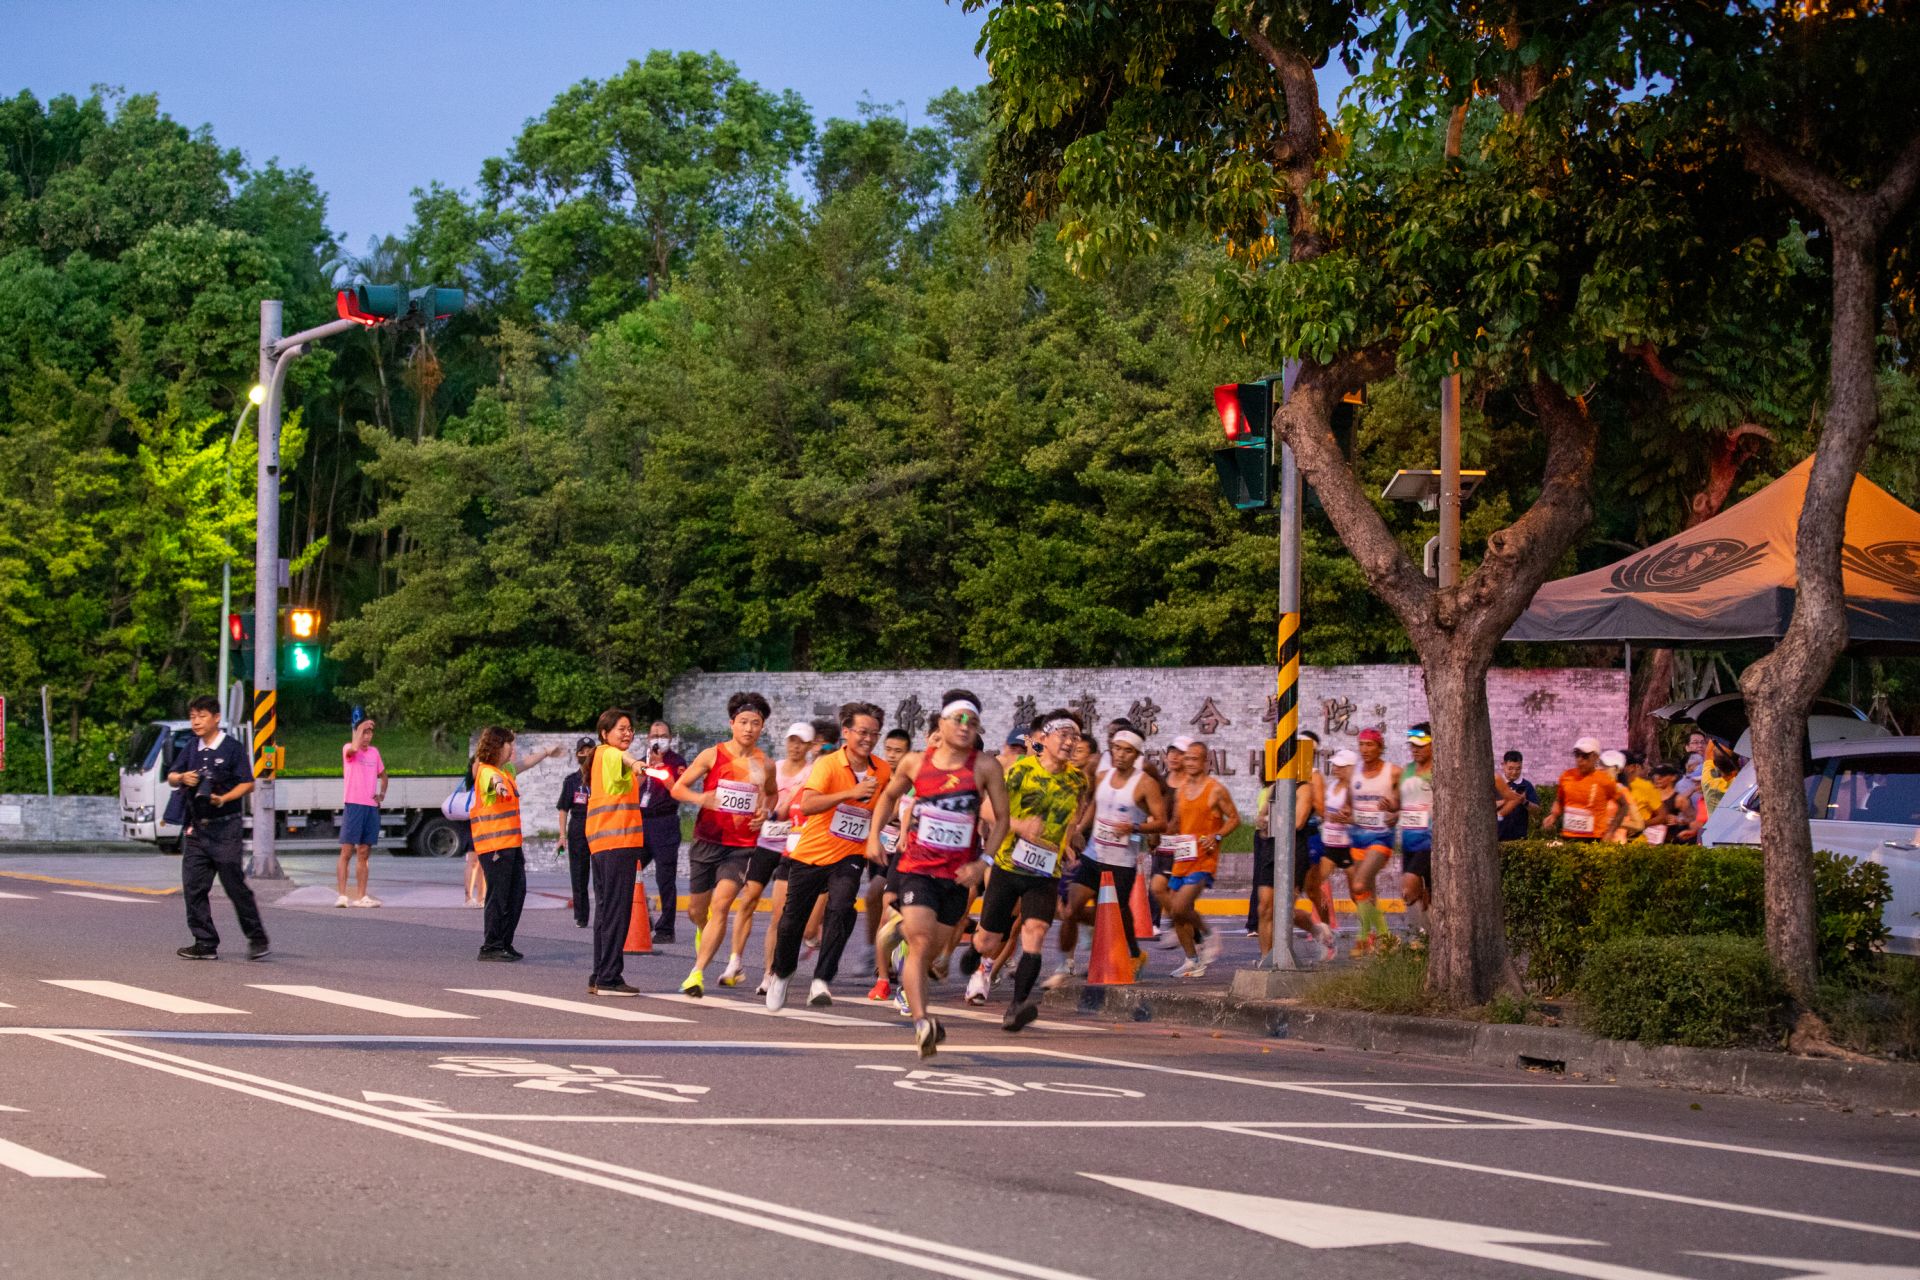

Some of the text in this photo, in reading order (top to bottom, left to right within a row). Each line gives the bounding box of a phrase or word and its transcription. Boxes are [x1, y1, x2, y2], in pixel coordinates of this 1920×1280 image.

[721, 795, 752, 811] 2085
[838, 820, 865, 838] 2127
[1023, 850, 1047, 869] 1014
